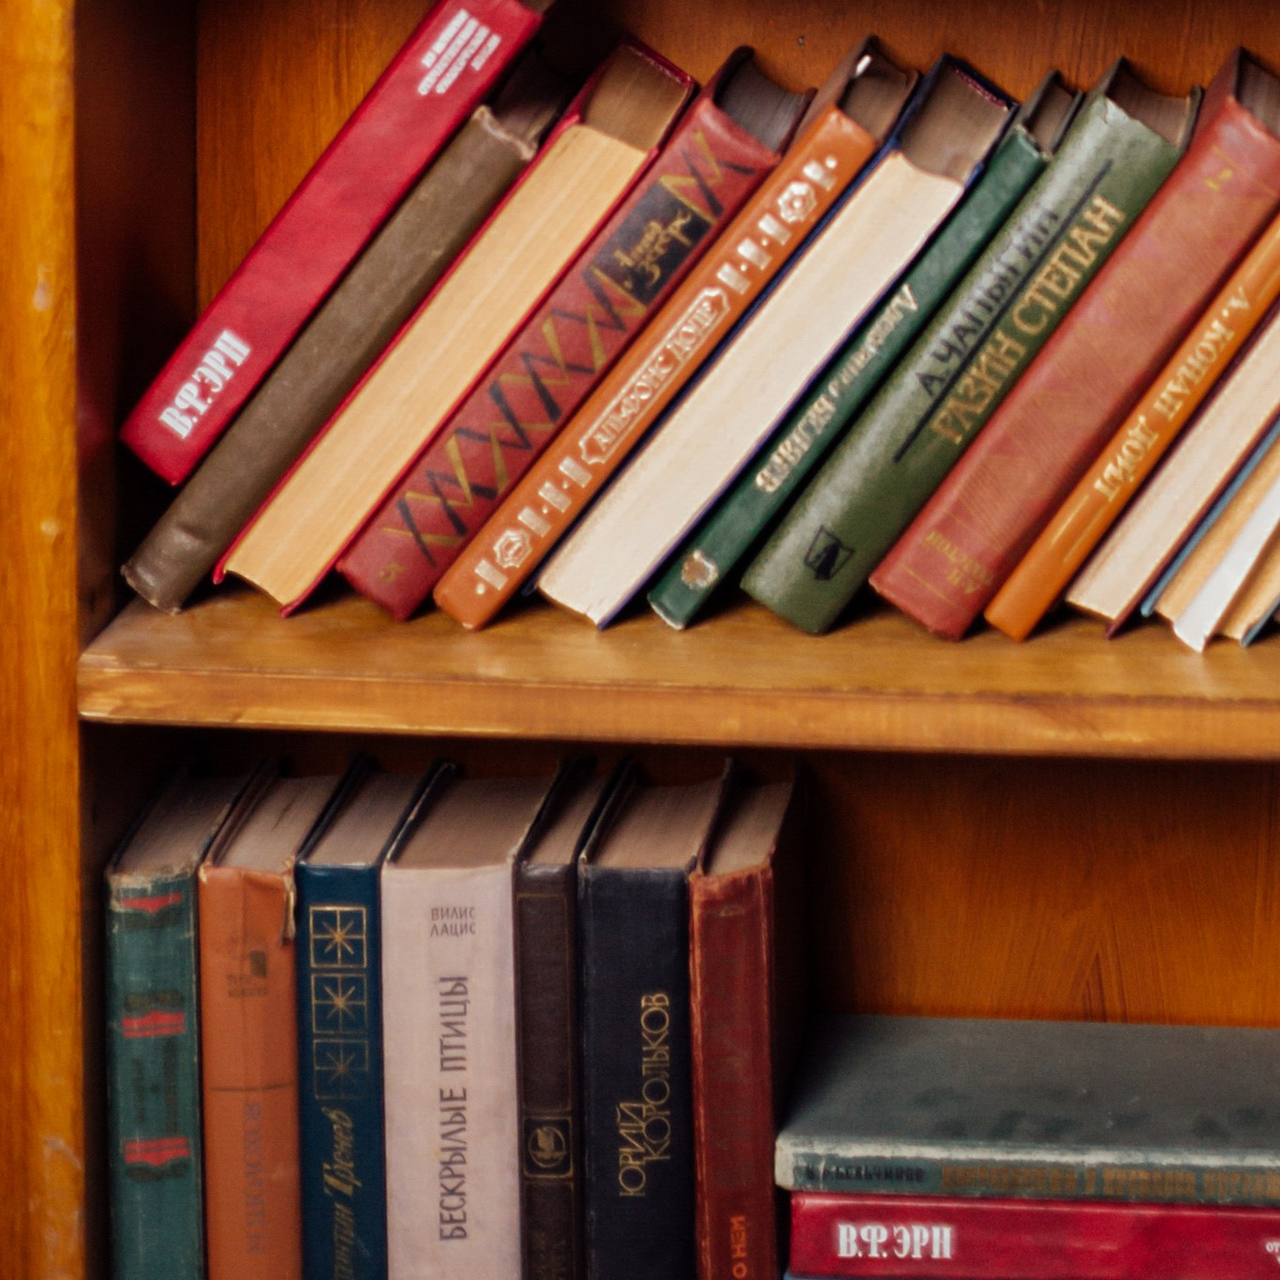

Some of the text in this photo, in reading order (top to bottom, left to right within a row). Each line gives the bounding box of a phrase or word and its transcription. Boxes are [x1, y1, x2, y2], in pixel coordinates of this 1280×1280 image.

[930, 191, 1127, 446] РАЗИН СТЕПАН
[1149, 317, 1236, 421] КОНАН
[1086, 414, 1162, 502] ДОЙЛ
[429, 921, 476, 937] ЛАЦИС
[430, 906, 476, 921] ВИЛИС
[438, 976, 470, 1240] БЕСКРЫЛЫЕ ПТИЦЫ
[640, 991, 671, 1161] КОРОЛЬКОВ
[616, 1101, 646, 1197] ЮРИЙ
